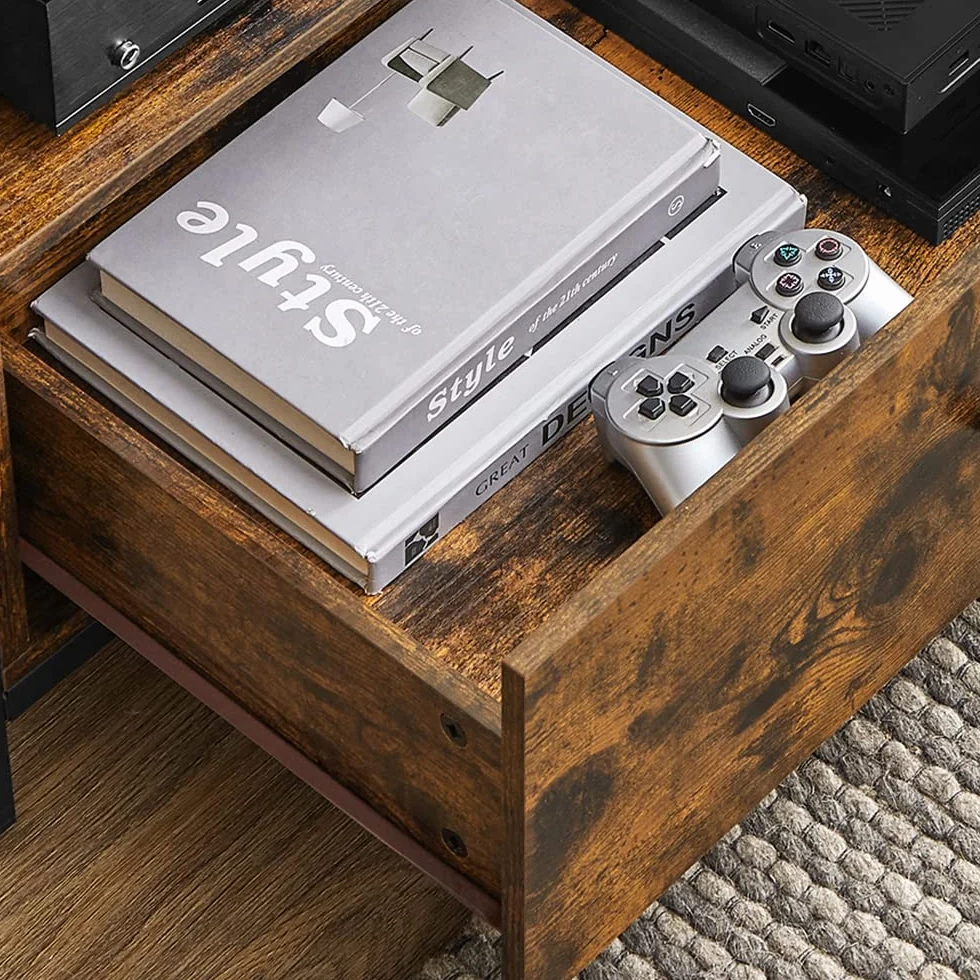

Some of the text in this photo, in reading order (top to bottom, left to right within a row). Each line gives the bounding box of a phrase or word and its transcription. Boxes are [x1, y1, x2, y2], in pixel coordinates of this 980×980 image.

[176, 201, 382, 348] Style
[320, 264, 364, 294] century
[385, 310, 408, 326] the
[760, 313, 779, 330] START
[400, 324, 422, 336] of
[427, 335, 516, 422] Style
[528, 314, 542, 333] of
[542, 303, 558, 322] the
[559, 282, 581, 308] 21th
[582, 252, 618, 288] century
[744, 333, 767, 355] ANALOG
[715, 350, 739, 370] SELECT
[475, 443, 530, 497] GREAT
